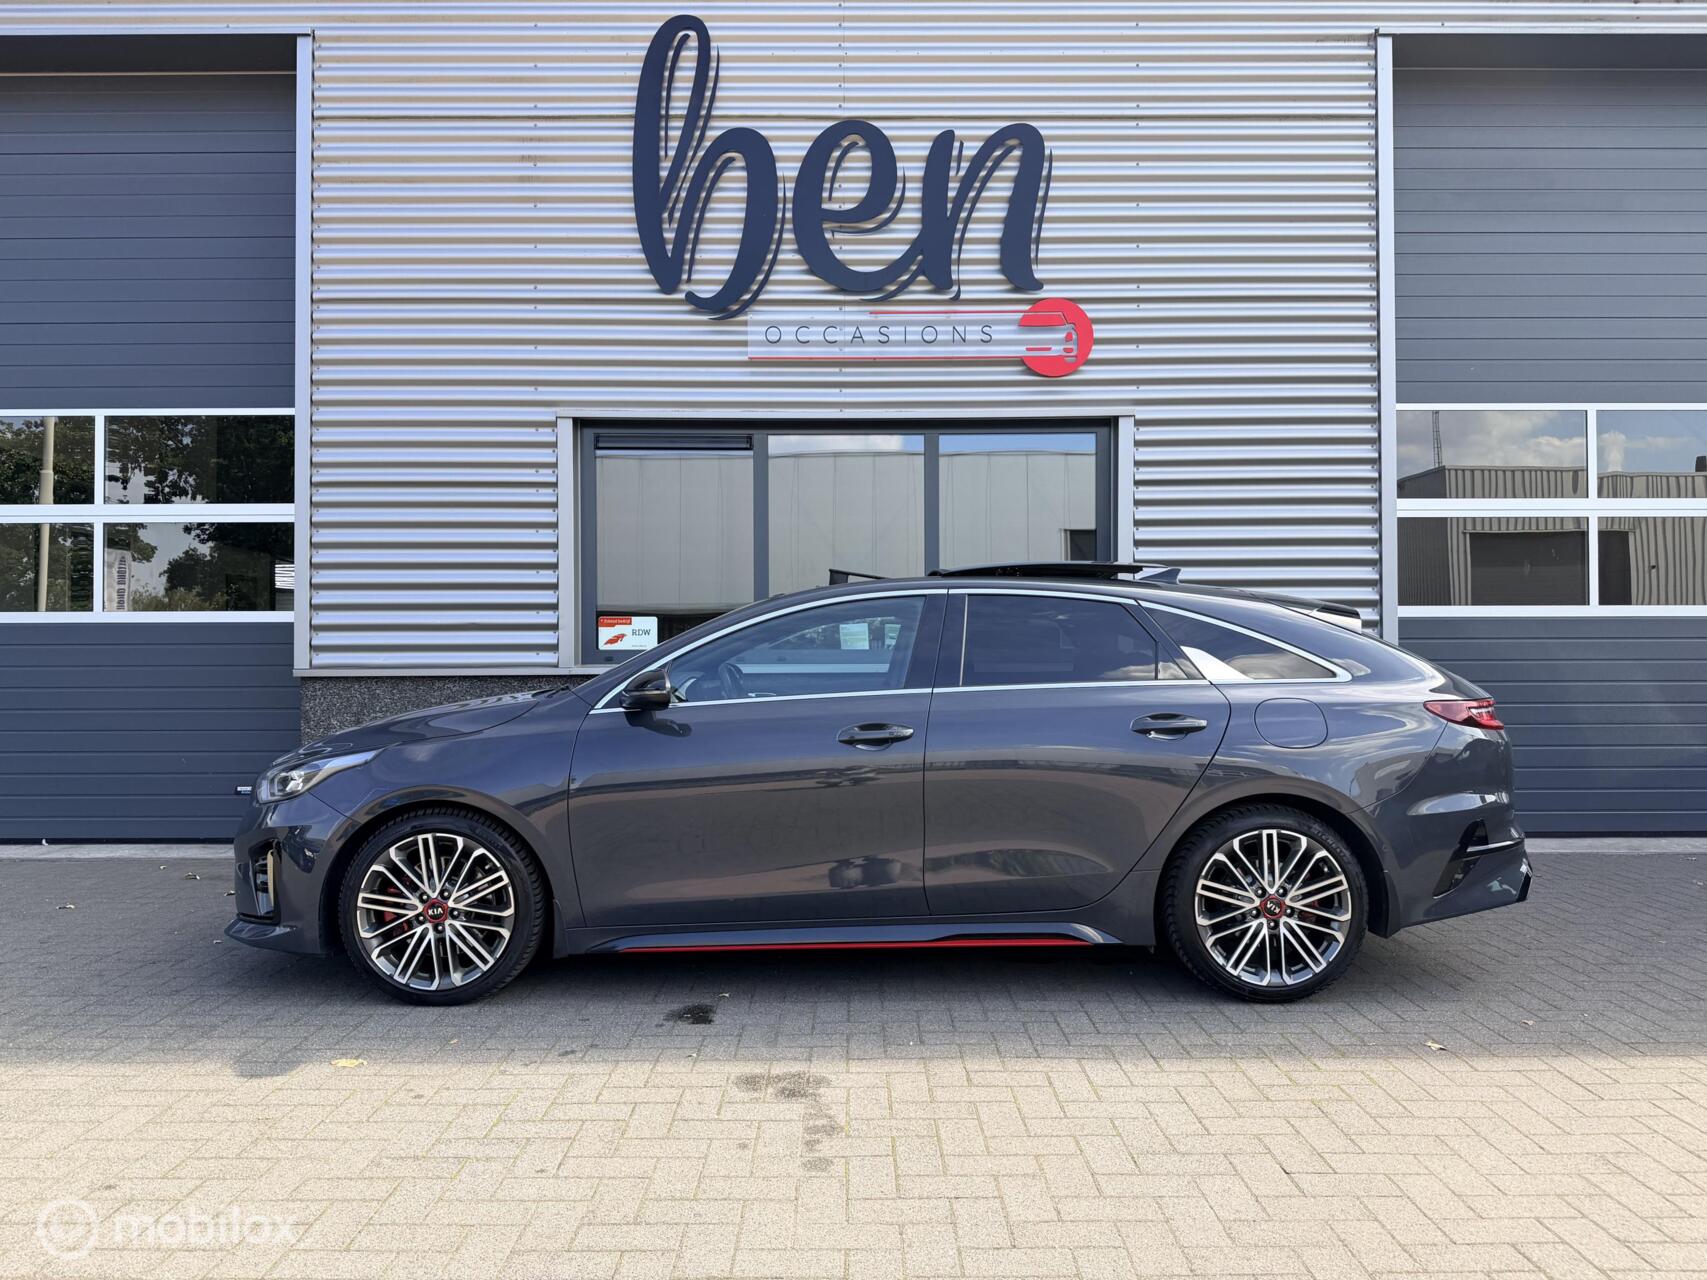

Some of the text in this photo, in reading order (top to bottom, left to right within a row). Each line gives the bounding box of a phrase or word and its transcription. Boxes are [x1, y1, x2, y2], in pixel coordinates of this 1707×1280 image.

[632, 14, 1052, 319] ben
[764, 324, 994, 345] OCCASIONS
[631, 628, 651, 636] RDW
[1267, 900, 1280, 913] KIA
